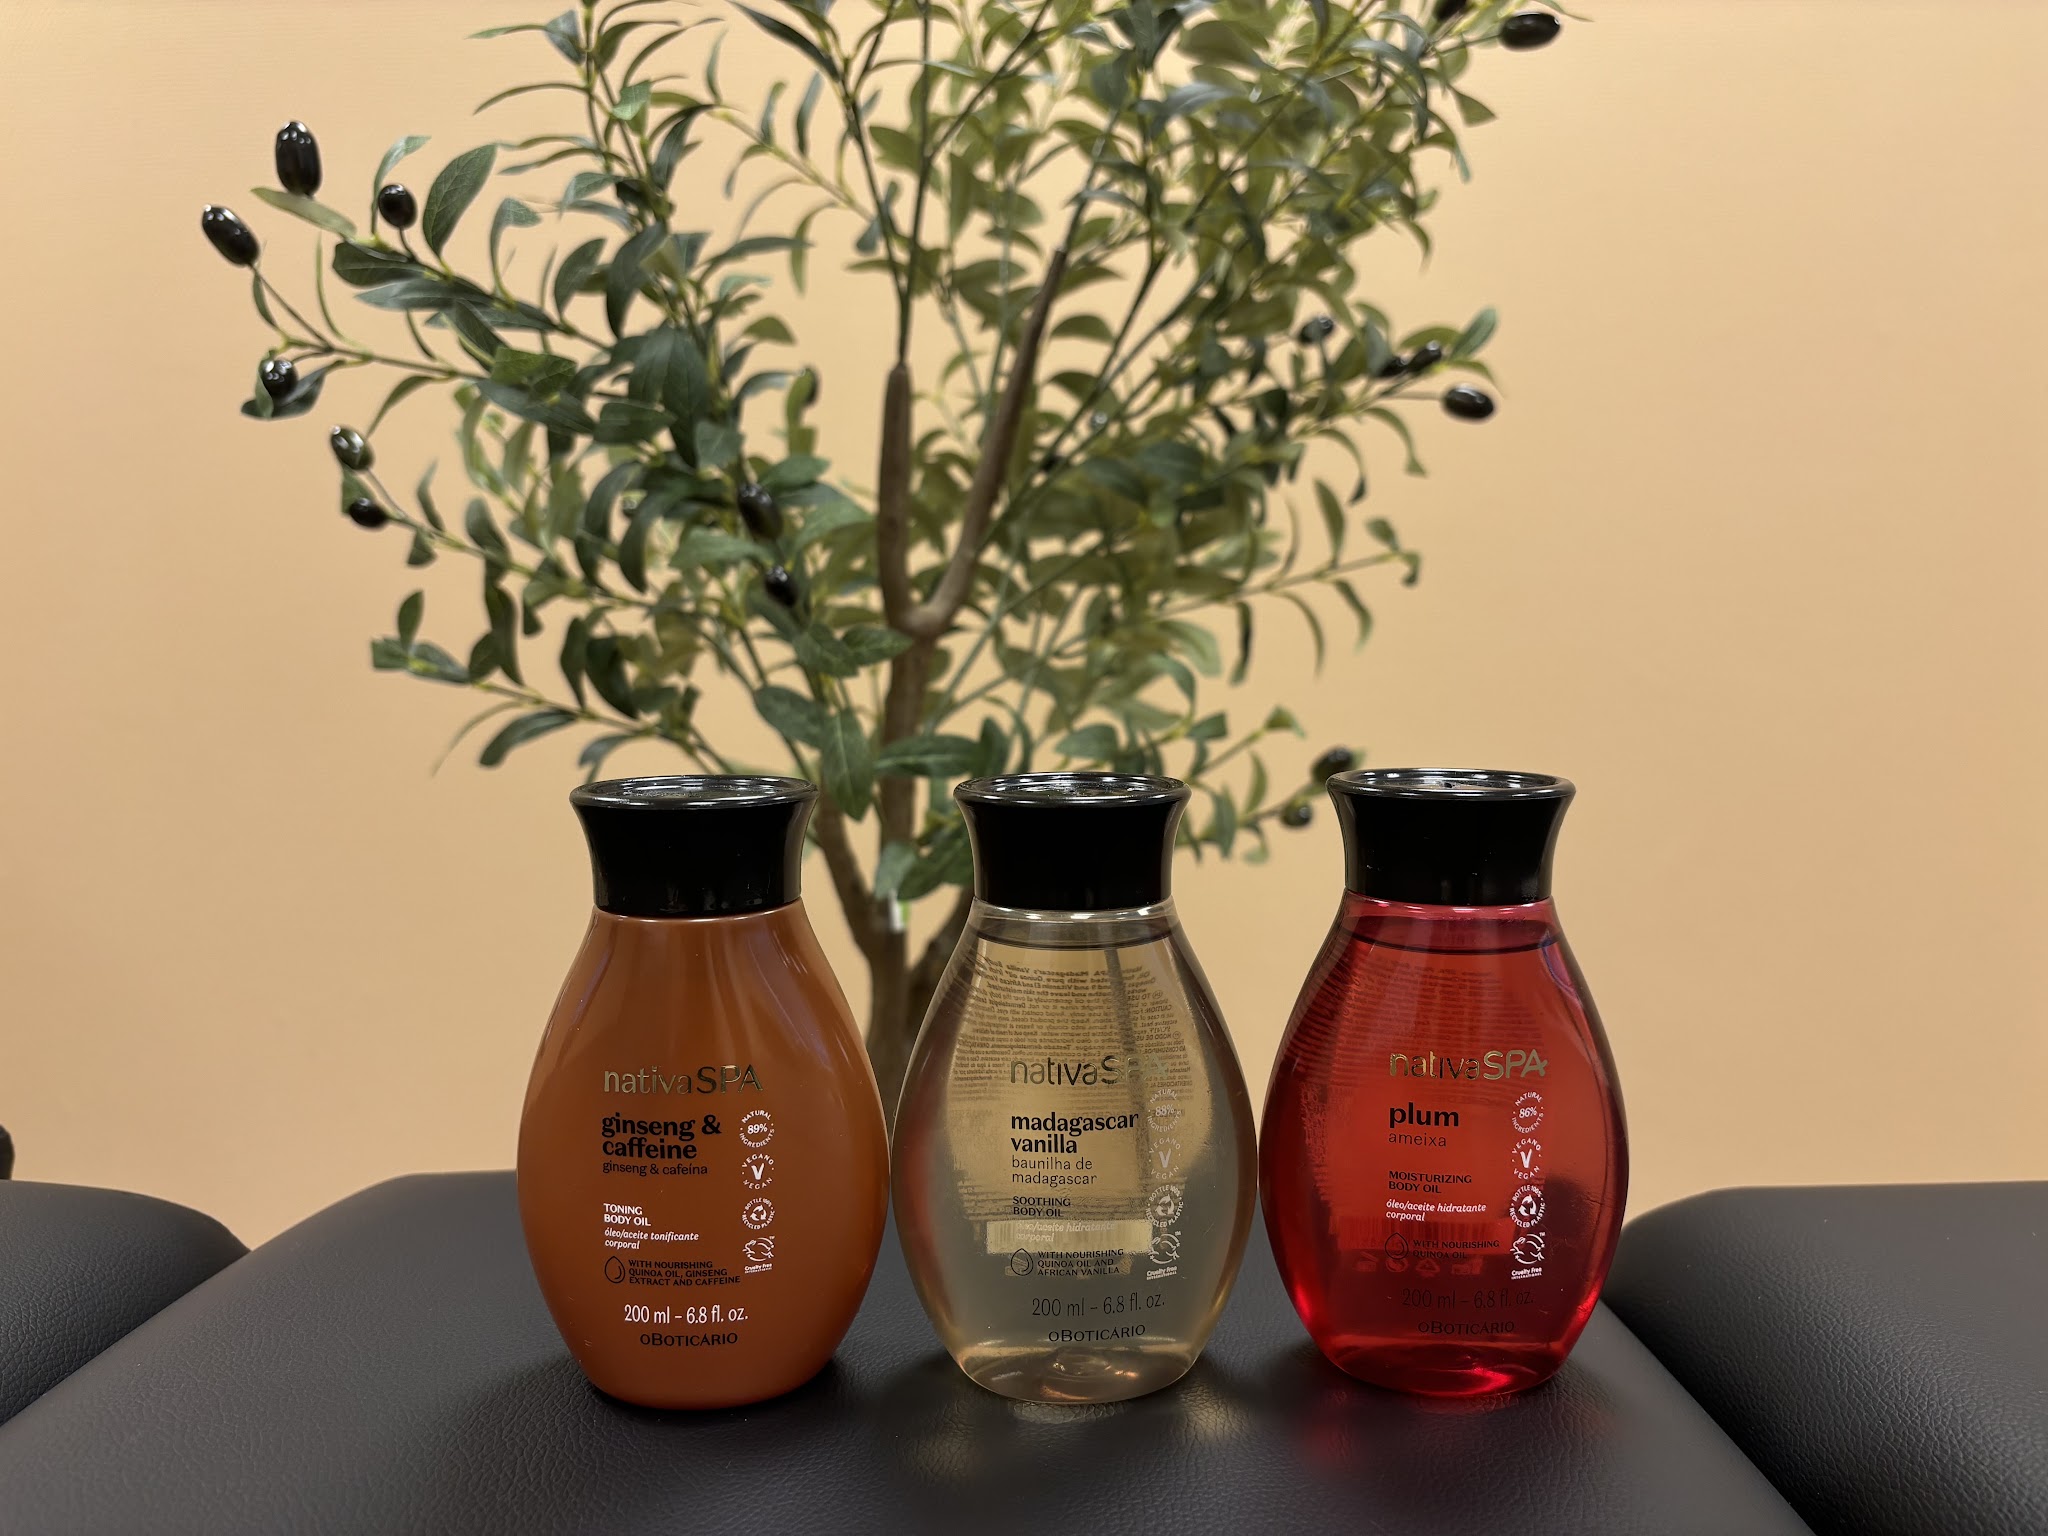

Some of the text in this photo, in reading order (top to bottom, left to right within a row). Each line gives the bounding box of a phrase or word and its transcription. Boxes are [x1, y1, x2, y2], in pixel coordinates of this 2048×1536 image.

[1150, 1089, 1177, 1103] NATURAL
[1515, 1092, 1542, 1106] NATURAL
[742, 1110, 771, 1123] NATURAL
[1389, 1102, 1459, 1128] plum
[1519, 1106, 1537, 1118] 86%
[601, 1112, 722, 1142] ginseng &
[748, 1123, 767, 1134] 89%
[1011, 1112, 1138, 1137] madagascar
[1512, 1113, 1543, 1133] INGREDIENTS
[740, 1129, 774, 1148] INGREDIENTS
[1011, 1134, 1078, 1154] vanilla
[1149, 1137, 1180, 1153] VEGANO
[1388, 1132, 1447, 1147] ameixa
[1512, 1138, 1541, 1153] VEGANO
[602, 1137, 697, 1159] caffeine
[742, 1154, 774, 1167] VEGANO
[1012, 1154, 1092, 1170] baunilha de
[602, 1160, 708, 1176] ginseng & cafeína
[1151, 1166, 1179, 1179] VEGAN
[1514, 1166, 1540, 1179] VEGAN
[743, 1178, 772, 1189] VEGAN
[1012, 1172, 1097, 1188] madagascar
[1388, 1170, 1472, 1184] MOISTURIZING
[1149, 1185, 1169, 1201] BOTTLE
[1388, 1181, 1442, 1194] BODY OIL
[1512, 1185, 1530, 1201] BOTTLE
[1012, 1196, 1071, 1206] SOOTHING
[1386, 1199, 1486, 1213] óleo/aceite hidratante
[603, 1203, 643, 1215] TONING
[1014, 1206, 1064, 1218] BODY OIL
[1168, 1202, 1183, 1225] PLASTIC
[1509, 1202, 1545, 1227] RECYCLED PLASTIC
[603, 1214, 651, 1226] BODY OIL
[1386, 1211, 1425, 1222] corporal
[604, 1227, 699, 1242] óleo/aceite tonificante
[604, 1238, 640, 1250] corporal
[1412, 1240, 1500, 1249] WITH NOURISHING
[1037, 1248, 1124, 1258] WITH NOURISHING
[1412, 1250, 1450, 1260] QUINOA
[628, 1259, 713, 1269] WITH NOURISHING
[1037, 1258, 1114, 1268] QUINOA OIL AND
[628, 1268, 728, 1278] QUINOA OIL, GINSENG
[1037, 1266, 1120, 1276] AFRICAN VANILLA
[1512, 1268, 1530, 1276] Cruelty
[629, 1276, 740, 1286] EXTRACT AND CAFFEINE
[1032, 1298, 1062, 1316] 200
[1067, 1298, 1084, 1316] ml
[1103, 1295, 1125, 1314] 6.8
[1130, 1292, 1142, 1311] fl.
[1146, 1294, 1165, 1308] oz.
[1402, 1288, 1432, 1308] 200
[1438, 1290, 1456, 1308] ml
[1474, 1290, 1496, 1309] 6.8
[1516, 1291, 1534, 1305] oz.
[624, 1304, 650, 1323] 200
[654, 1306, 670, 1324] ml
[686, 1306, 708, 1324] 6.8
[711, 1304, 724, 1323] fl.
[728, 1307, 748, 1322] oz.
